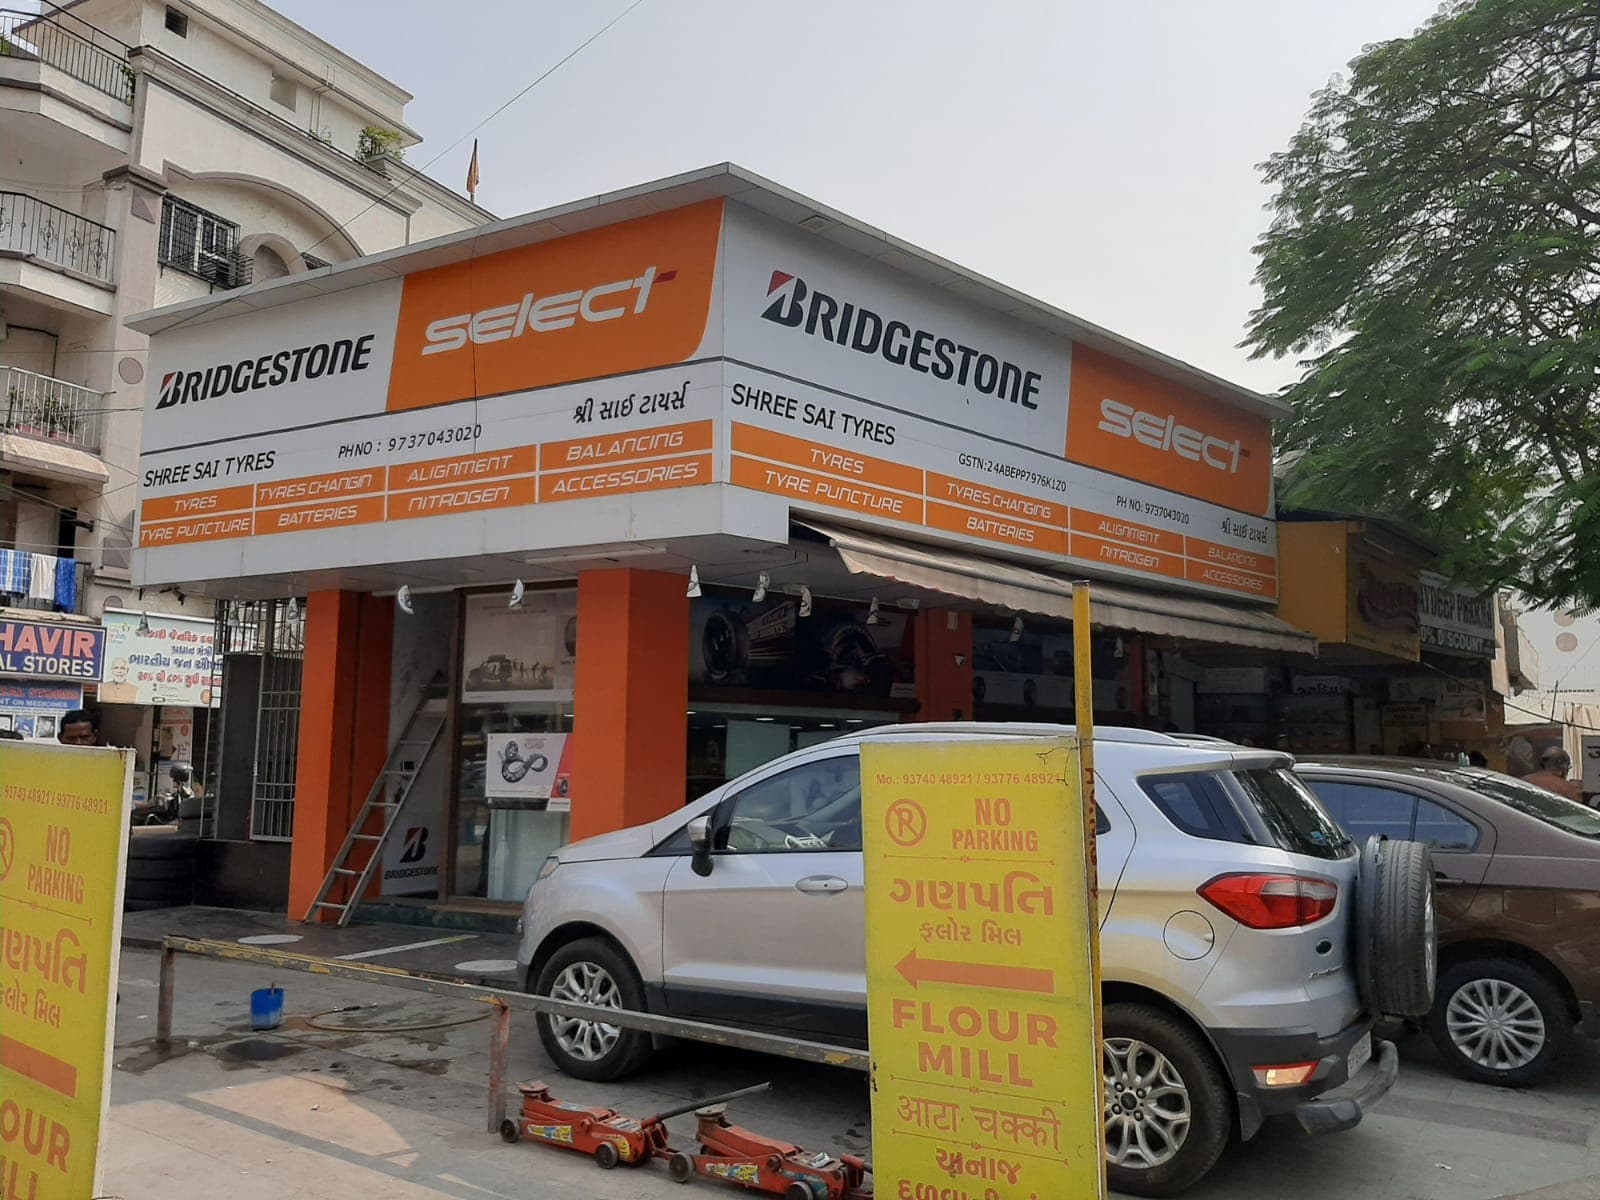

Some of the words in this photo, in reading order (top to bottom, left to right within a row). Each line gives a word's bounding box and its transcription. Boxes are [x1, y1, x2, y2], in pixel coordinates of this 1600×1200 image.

[760, 269, 1042, 410] BRIDGESTONE
[155, 334, 375, 410] BRIDGESTONE
[573, 397, 594, 424] શ્રી
[600, 393, 636, 420] સાઈ
[639, 381, 691, 414] ટાયર્સ
[731, 383, 798, 420] SHREE
[803, 402, 835, 431] SAI
[841, 413, 897, 446] TYRES
[388, 423, 483, 452] 9737043020
[566, 431, 684, 462] BALANCING
[143, 464, 191, 487] SHREE
[193, 459, 220, 480] SAI
[225, 450, 276, 475] TYRES
[407, 454, 513, 483] ALIGNMENT
[810, 448, 865, 474] TYRES
[260, 483, 307, 501] TYRES
[552, 462, 699, 494] ACCESSORIES
[766, 470, 809, 494] TYRE
[815, 478, 903, 514] PUNCTURE
[175, 495, 217, 512] TYRES
[408, 486, 511, 511] NITROGEN
[947, 483, 991, 504] TYRES
[992, 495, 1051, 519] CHANGING
[1116, 495, 1127, 509] PH
[1145, 503, 1189, 525] 9737043020
[141, 527, 175, 542] TYRE
[176, 518, 250, 538] PUNCTURE
[278, 505, 359, 527] BATTERIES
[967, 517, 1035, 543] BATTERIES
[1098, 521, 1160, 544] ALIGNMENT
[1100, 545, 1159, 568] NITROGEN
[23, 655, 94, 676] STORES
[903, 774, 935, 785] 93740
[939, 774, 973, 785] 48921
[985, 773, 1019, 785] 93776
[83, 797, 108, 815] 48921
[973, 797, 1011, 827] NO
[46, 825, 71, 867] NO
[952, 828, 1039, 852] PARKING
[27, 863, 85, 905] PARKING
[889, 870, 1054, 916] ગણપતિ
[982, 918, 1022, 946] મિલ
[34, 988, 61, 1029] મિલ
[892, 998, 1059, 1049] FLOUR
[917, 1041, 1034, 1088] MILL
[896, 1095, 961, 1134] आटा
